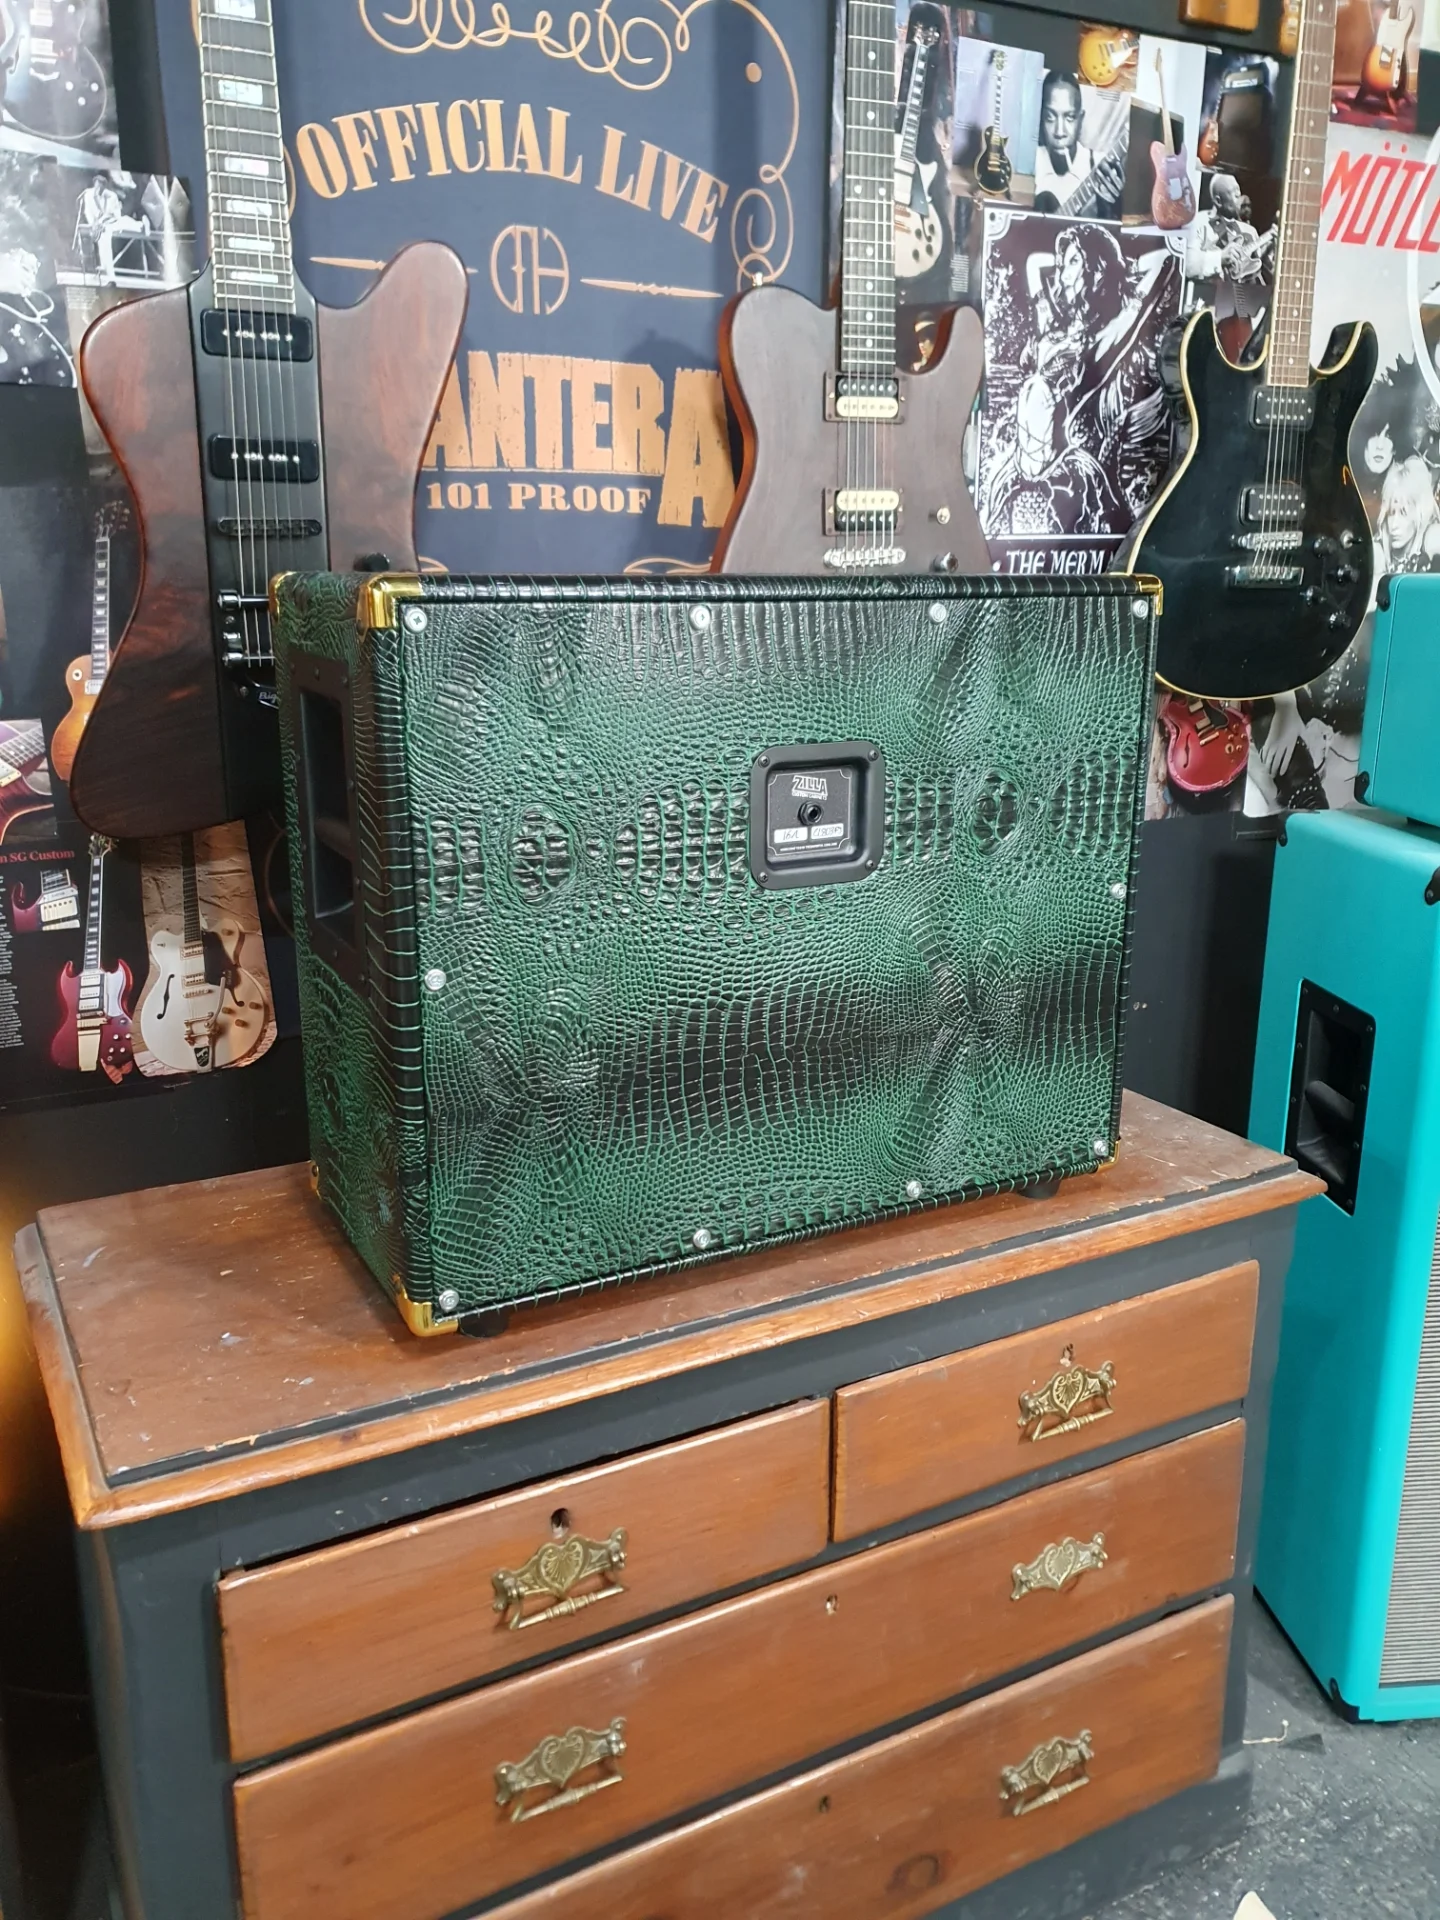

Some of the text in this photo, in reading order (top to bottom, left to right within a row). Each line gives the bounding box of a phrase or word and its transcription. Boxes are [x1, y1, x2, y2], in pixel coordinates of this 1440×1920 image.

[296, 98, 730, 243] OFFICIAL LIVE
[426, 482, 651, 514] 101 PROOF
[1006, 549, 1114, 575] THE MERM
[791, 775, 828, 797] ZILLA
[9, 851, 27, 863] SG
[29, 850, 75, 861] Custom
